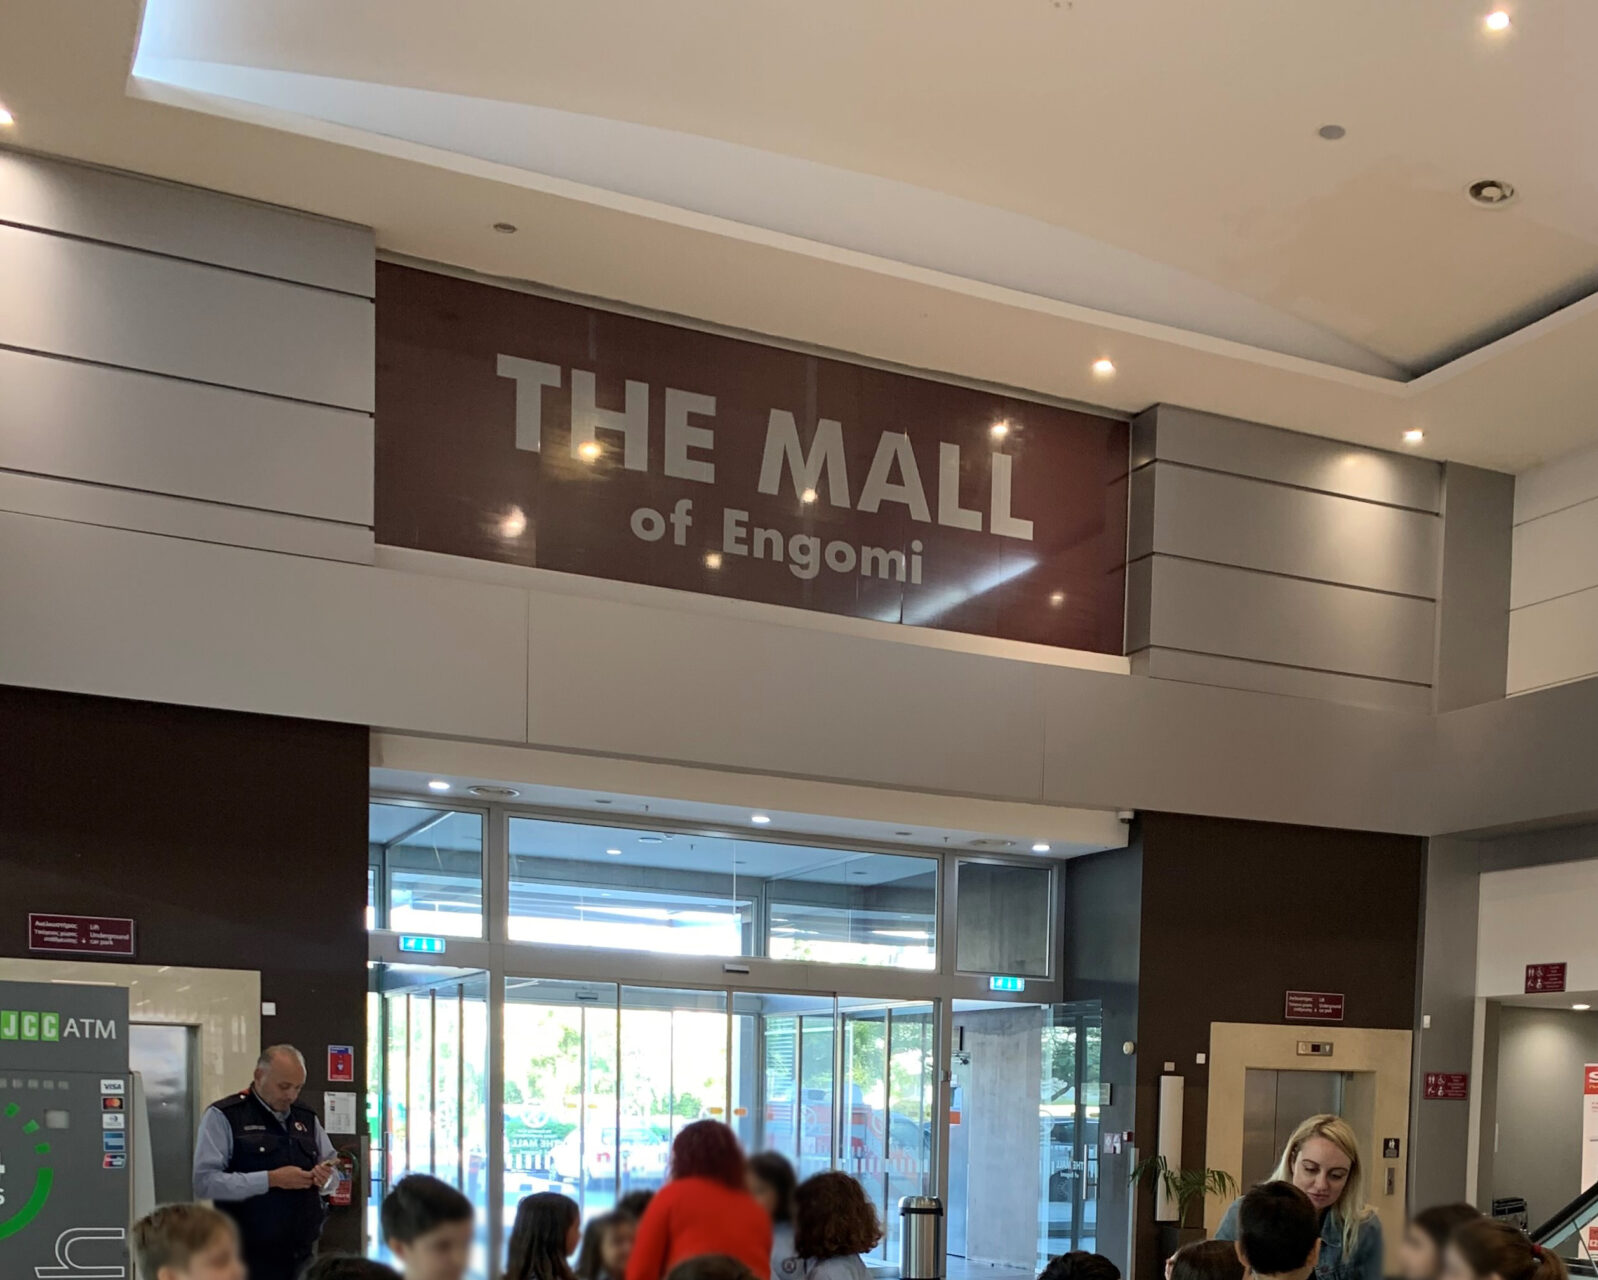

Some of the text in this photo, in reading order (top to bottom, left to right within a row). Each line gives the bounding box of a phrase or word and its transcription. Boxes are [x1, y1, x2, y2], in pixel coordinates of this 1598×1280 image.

[497, 353, 1034, 541] THE MALL
[630, 499, 924, 585] of Engomi
[3, 1014, 117, 1039] JCC ATM
